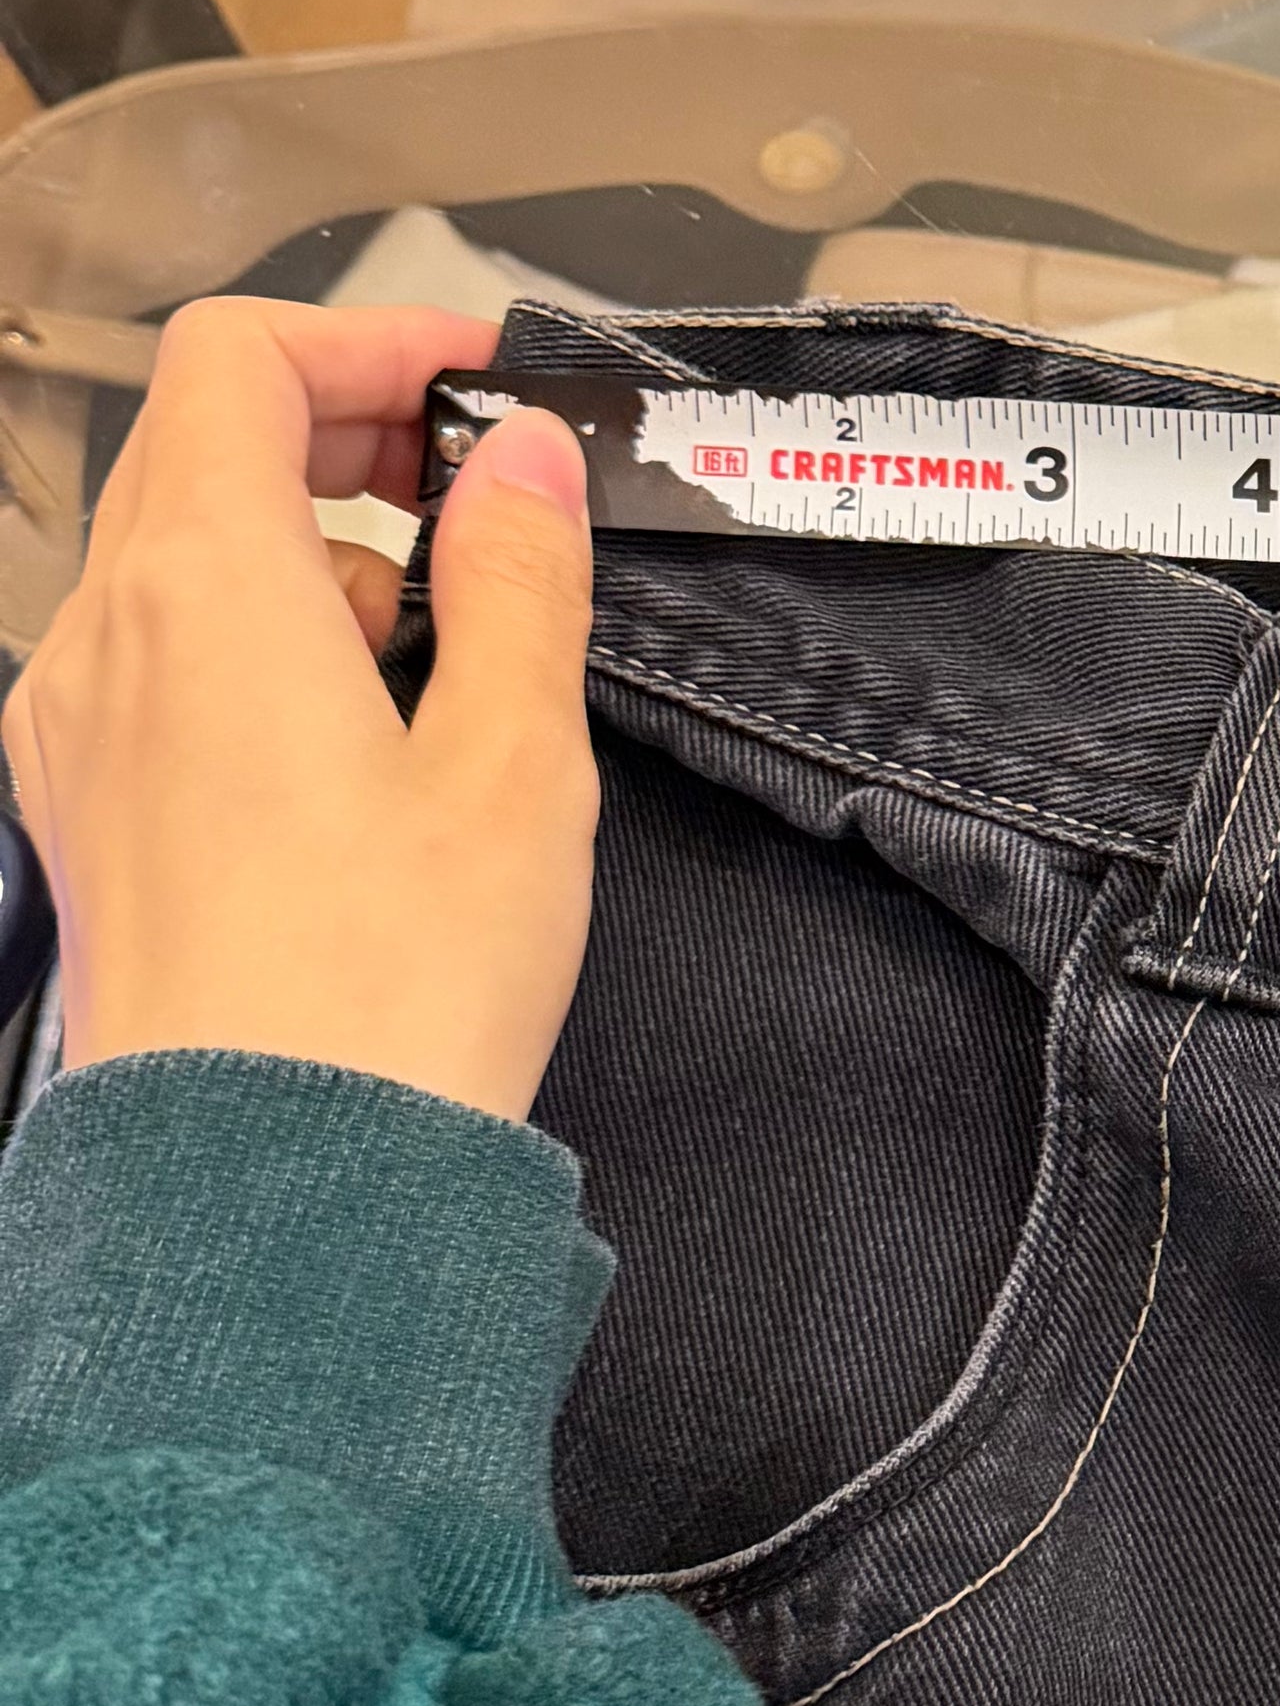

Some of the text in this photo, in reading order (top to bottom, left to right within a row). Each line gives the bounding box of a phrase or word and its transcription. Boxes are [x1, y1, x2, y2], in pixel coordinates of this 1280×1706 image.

[836, 418, 858, 442] 2
[1023, 446, 1069, 503] 3
[1231, 458, 1279, 513] 4
[834, 487, 857, 511] 2
